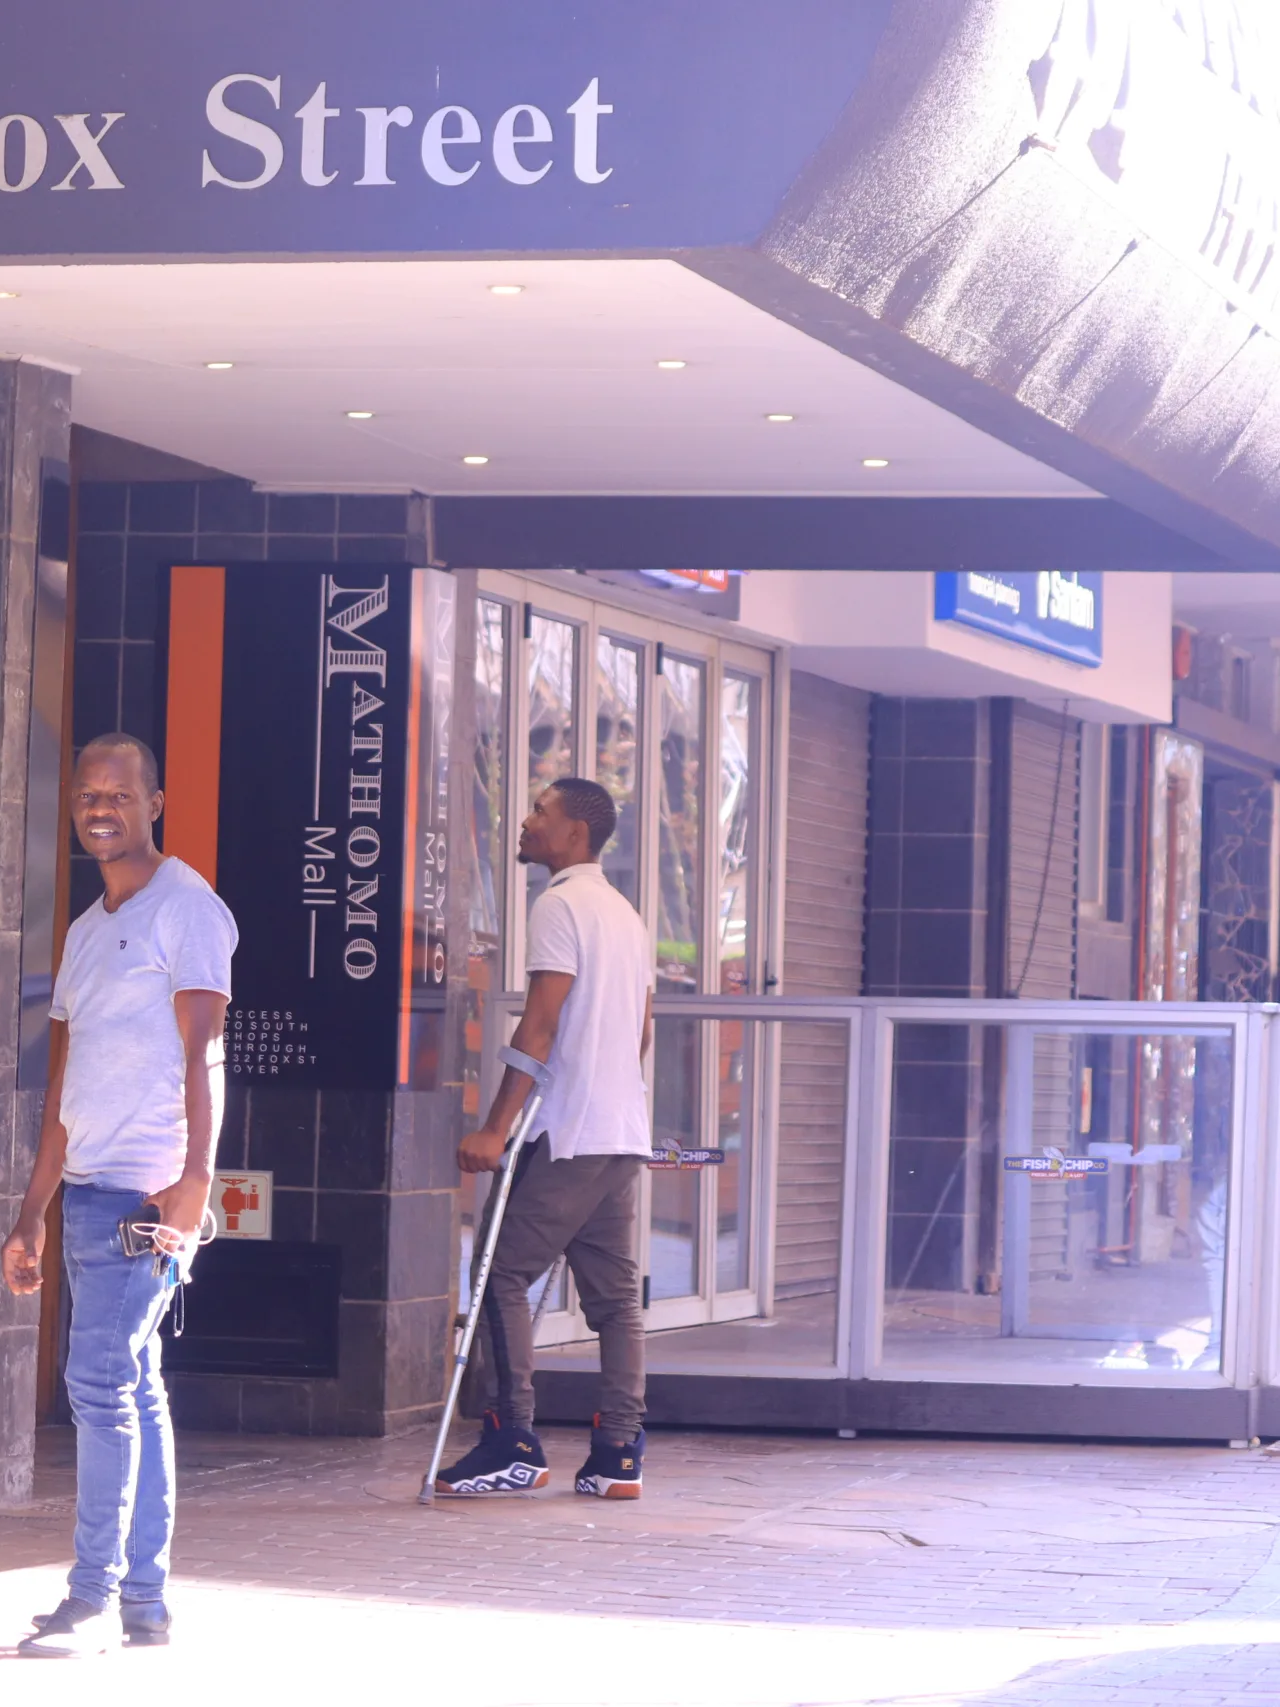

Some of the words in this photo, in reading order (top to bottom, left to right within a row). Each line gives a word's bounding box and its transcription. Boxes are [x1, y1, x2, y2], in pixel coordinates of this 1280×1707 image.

[201, 73, 614, 190] Street
[303, 827, 337, 905] Mall
[424, 832, 436, 910] Mall
[224, 1010, 293, 1020] ACCESS
[224, 1021, 243, 1030] TO
[250, 1022, 308, 1031] SOUTH
[223, 1032, 280, 1041] SHOPS
[224, 1043, 307, 1053] THROUGH
[232, 1054, 251, 1063] 32
[258, 1055, 290, 1063] FOX
[298, 1056, 317, 1064] ST
[682, 1151, 709, 1161] CHIP
[1022, 1159, 1051, 1170] FISH
[1065, 1160, 1093, 1170] CHIP
